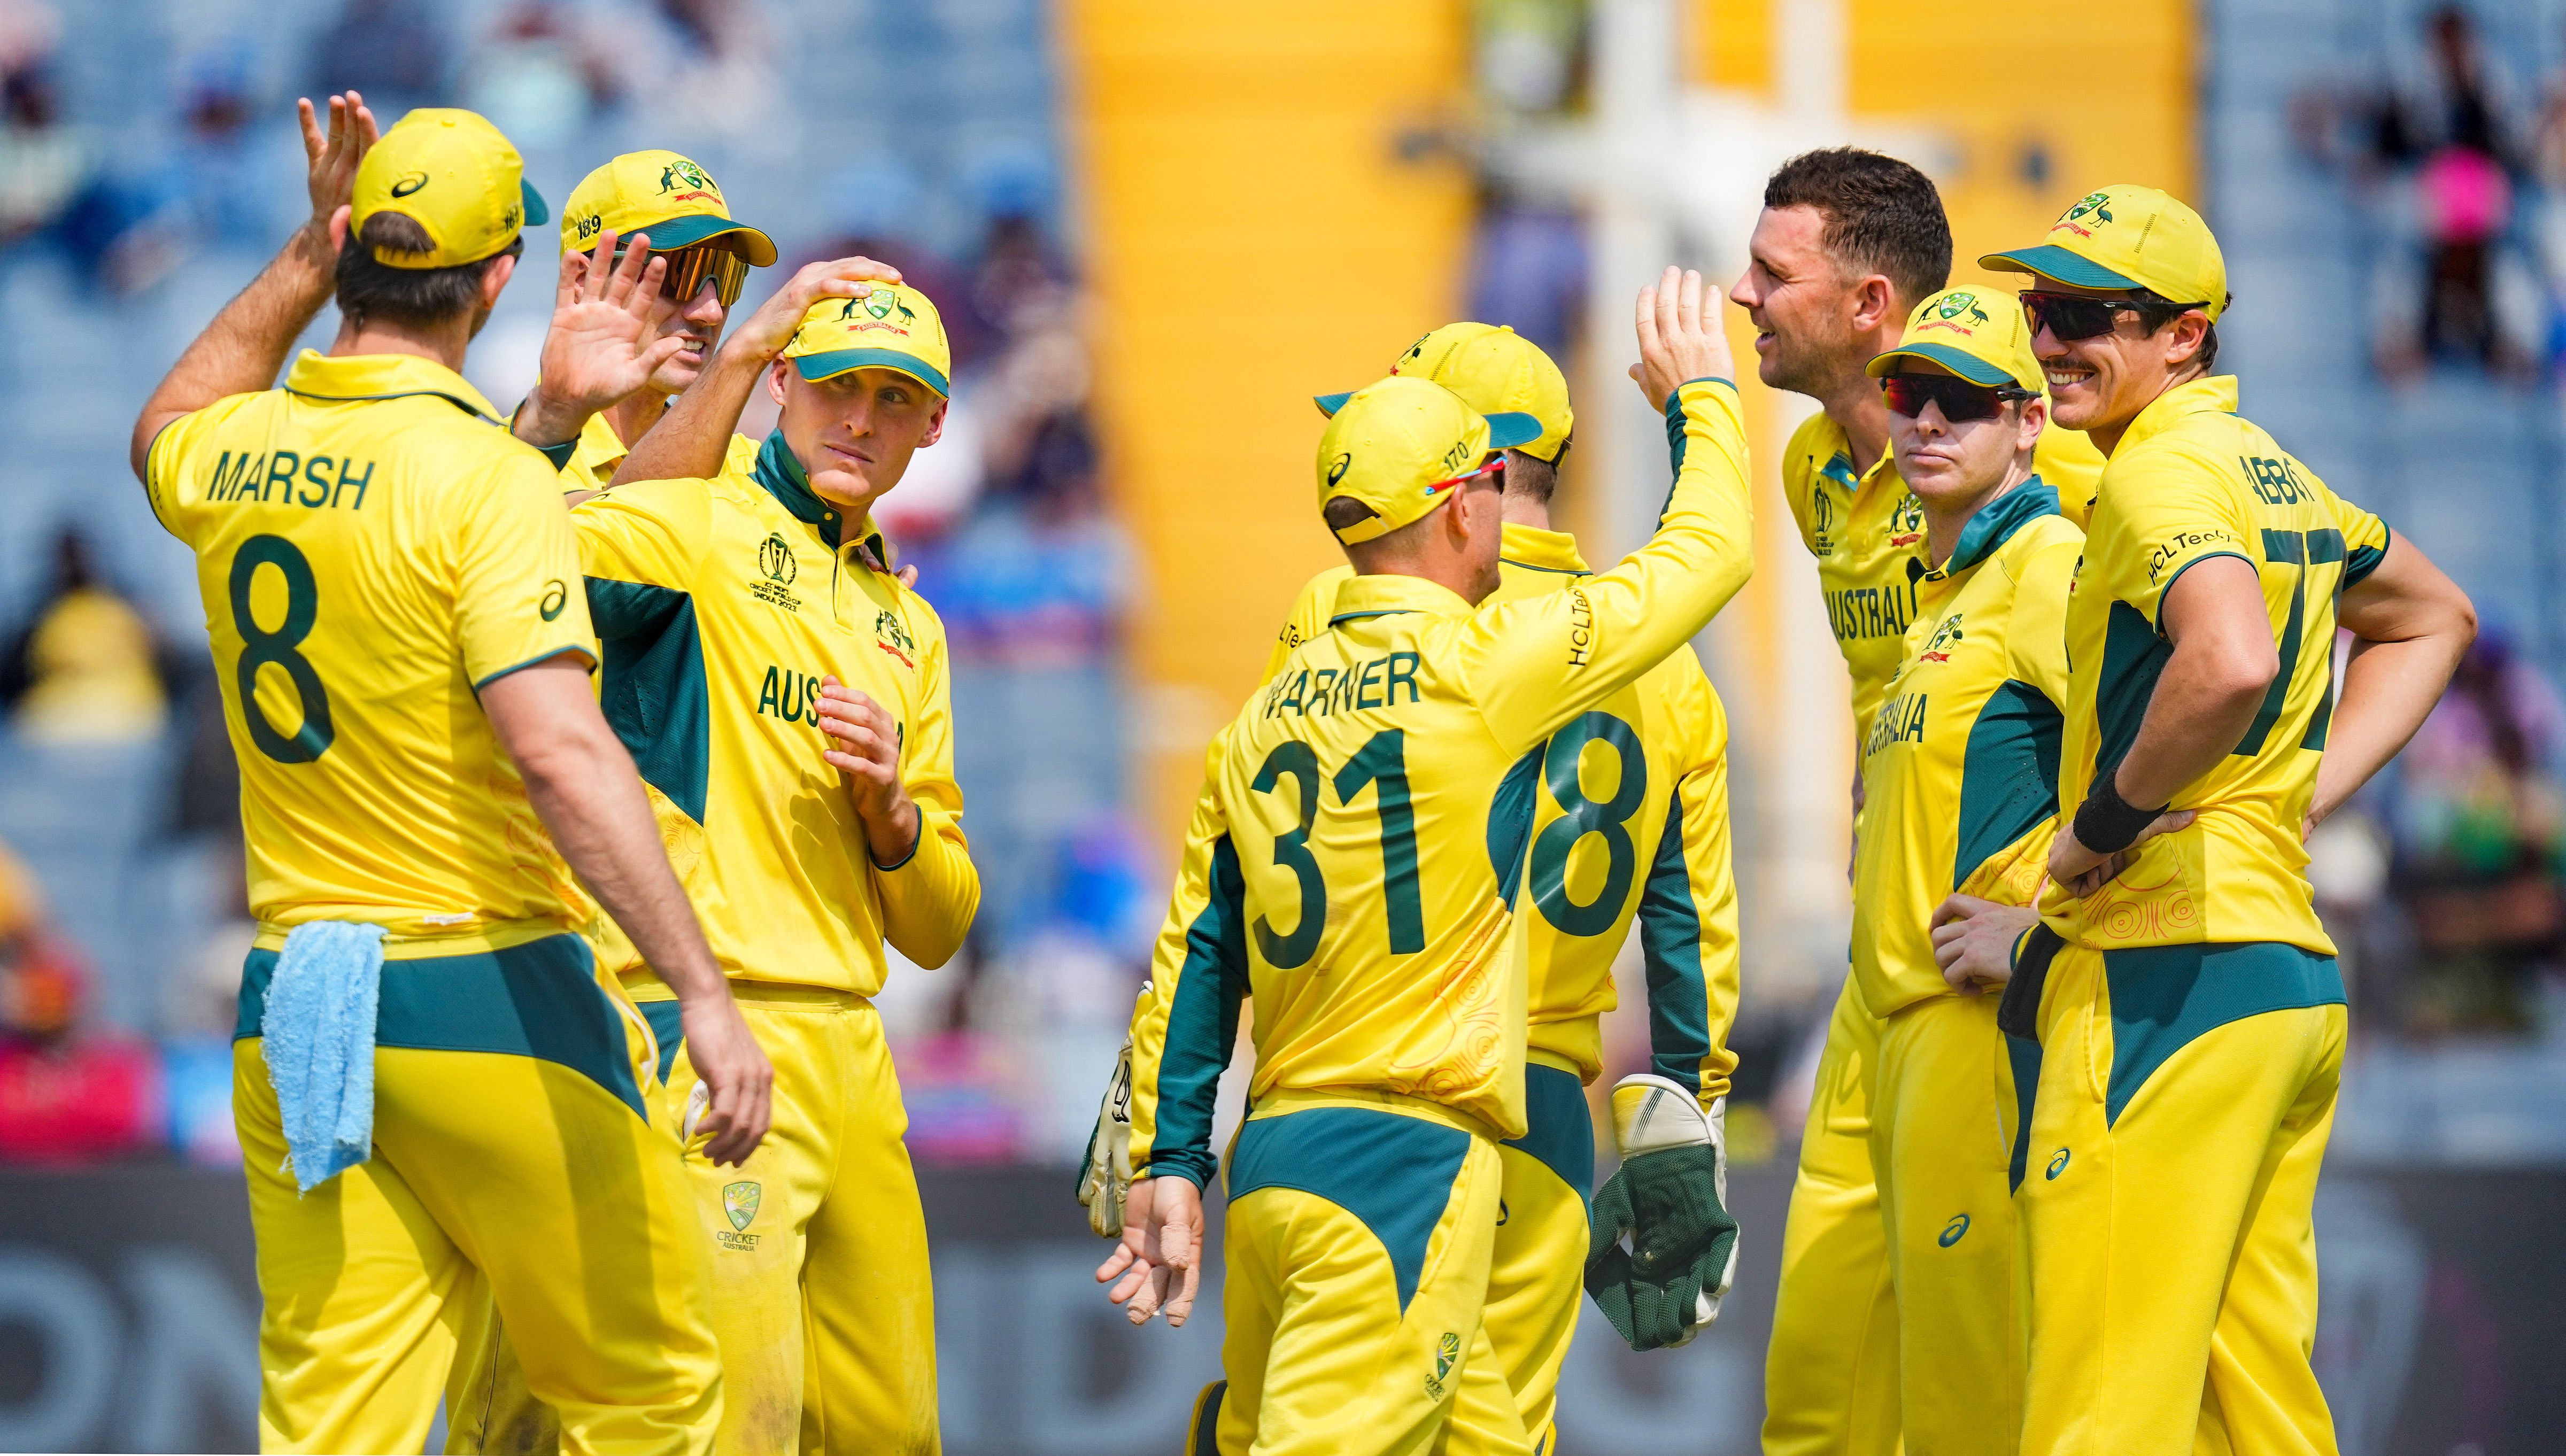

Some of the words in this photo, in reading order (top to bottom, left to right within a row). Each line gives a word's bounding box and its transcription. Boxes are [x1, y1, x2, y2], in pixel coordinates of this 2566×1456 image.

[578, 214, 601, 240] 189
[862, 322, 896, 333] AUSTRALIA
[1927, 321, 1960, 332] AUSTRALIA
[1444, 442, 1469, 472] 170
[206, 450, 375, 510] MARSH
[754, 591, 777, 605] INDIA
[778, 599, 797, 612] 2023
[1825, 584, 1918, 641] AUSTRALI
[229, 533, 335, 764] 8
[2231, 528, 2348, 757] 77
[1251, 728, 1426, 970] 31
[717, 1231, 761, 1245] CRICKET
[723, 1242, 755, 1252] AUSTRALIA
